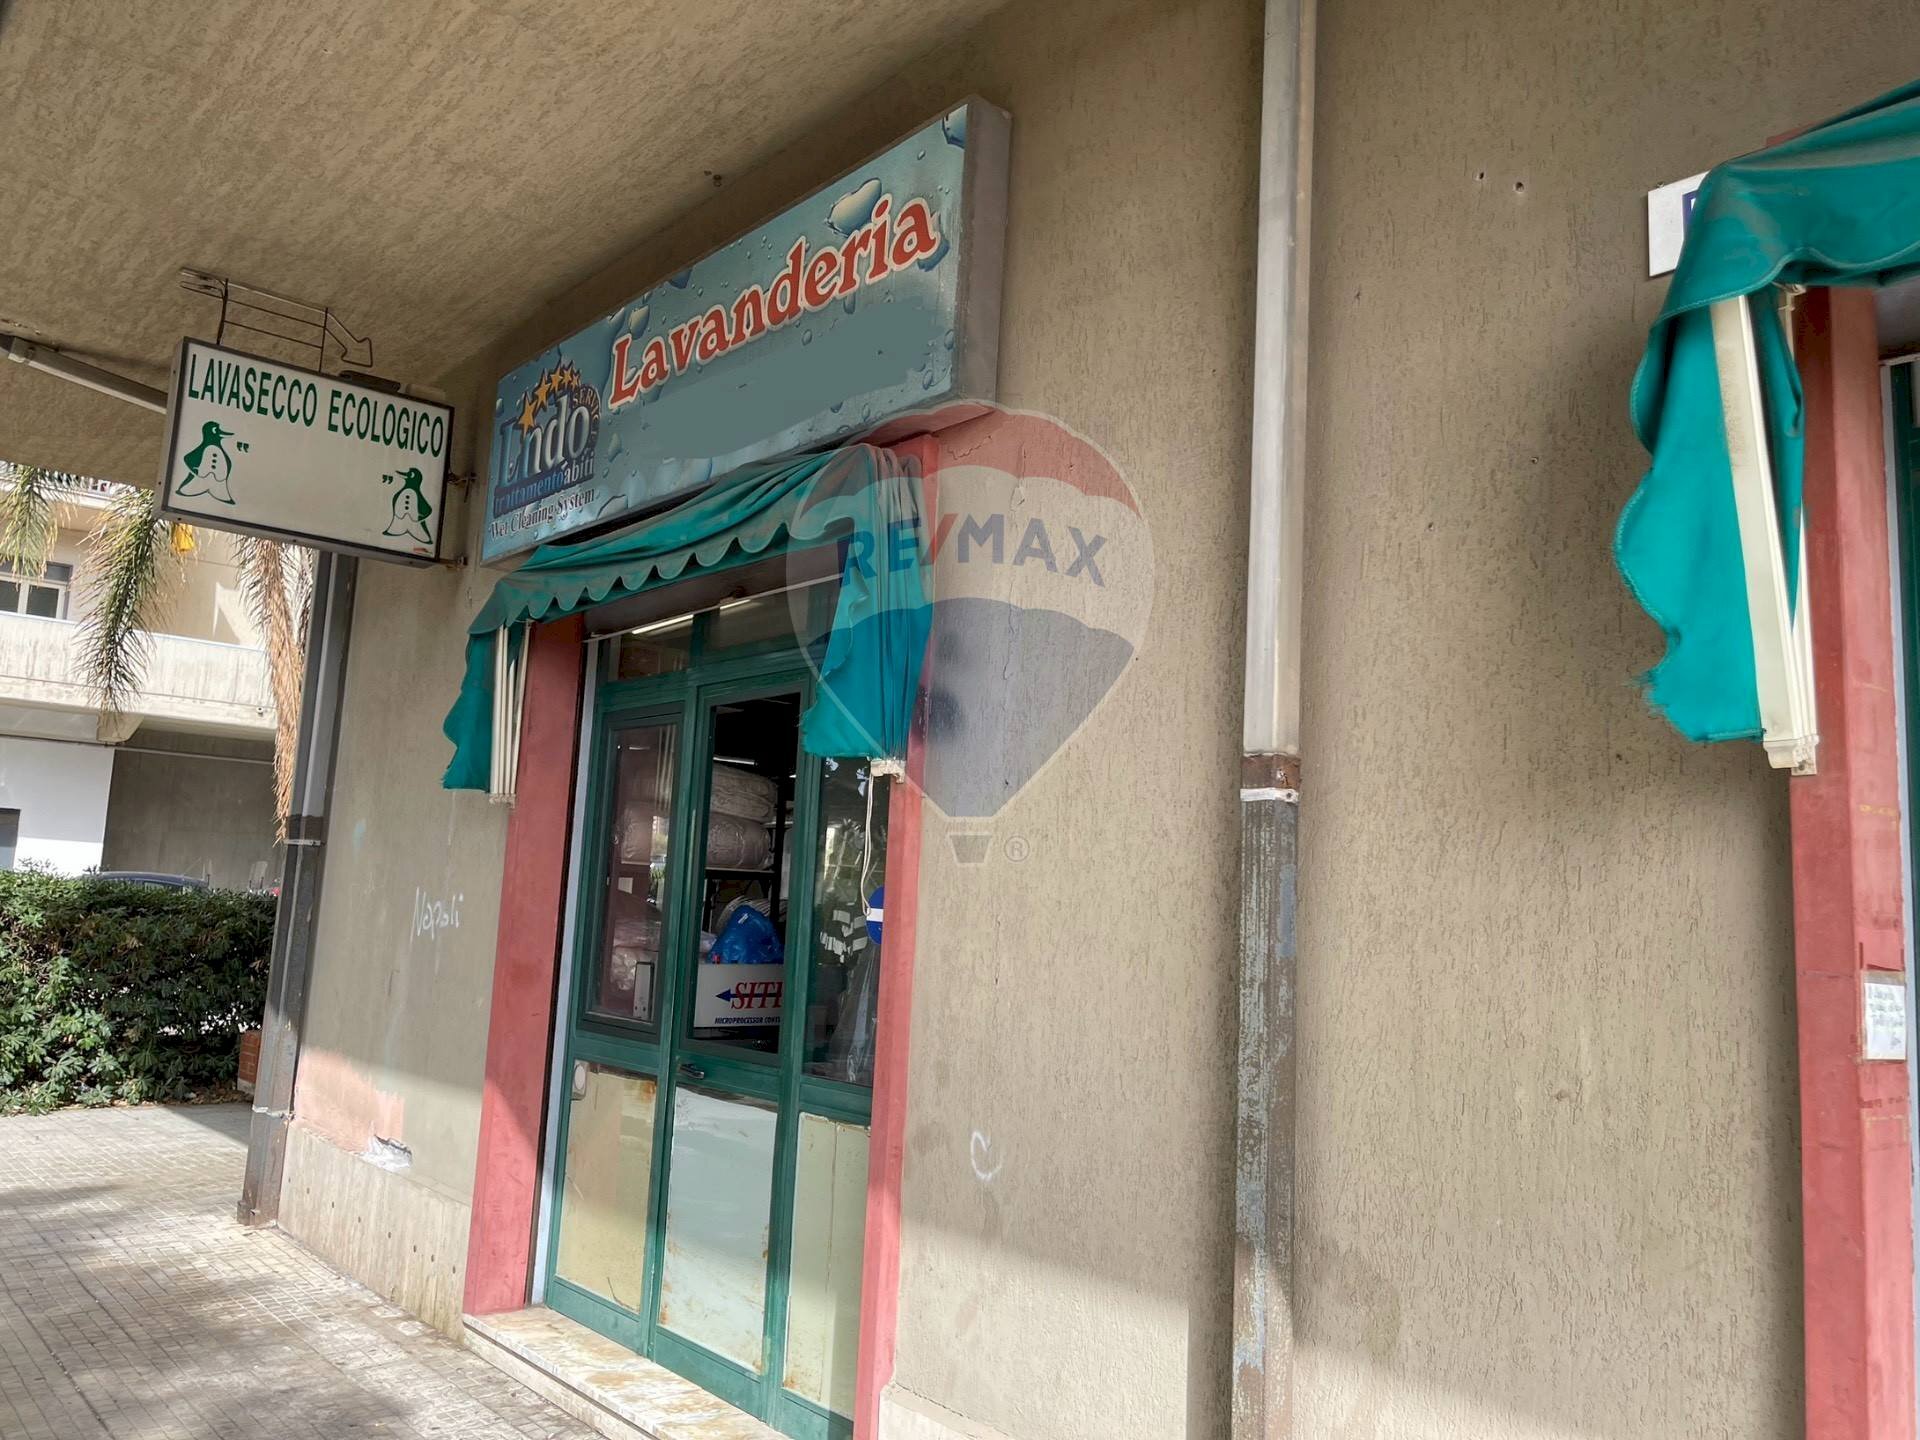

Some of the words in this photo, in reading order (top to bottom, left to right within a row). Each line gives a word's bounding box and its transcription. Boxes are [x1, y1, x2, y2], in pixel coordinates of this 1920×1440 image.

[608, 194, 940, 408] Lavanderia
[188, 353, 318, 428] LAVASECCO
[327, 388, 444, 458] ECOLOGICO
[489, 520, 509, 539] Wet
[511, 504, 555, 533] Cleaning
[556, 488, 595, 518] System
